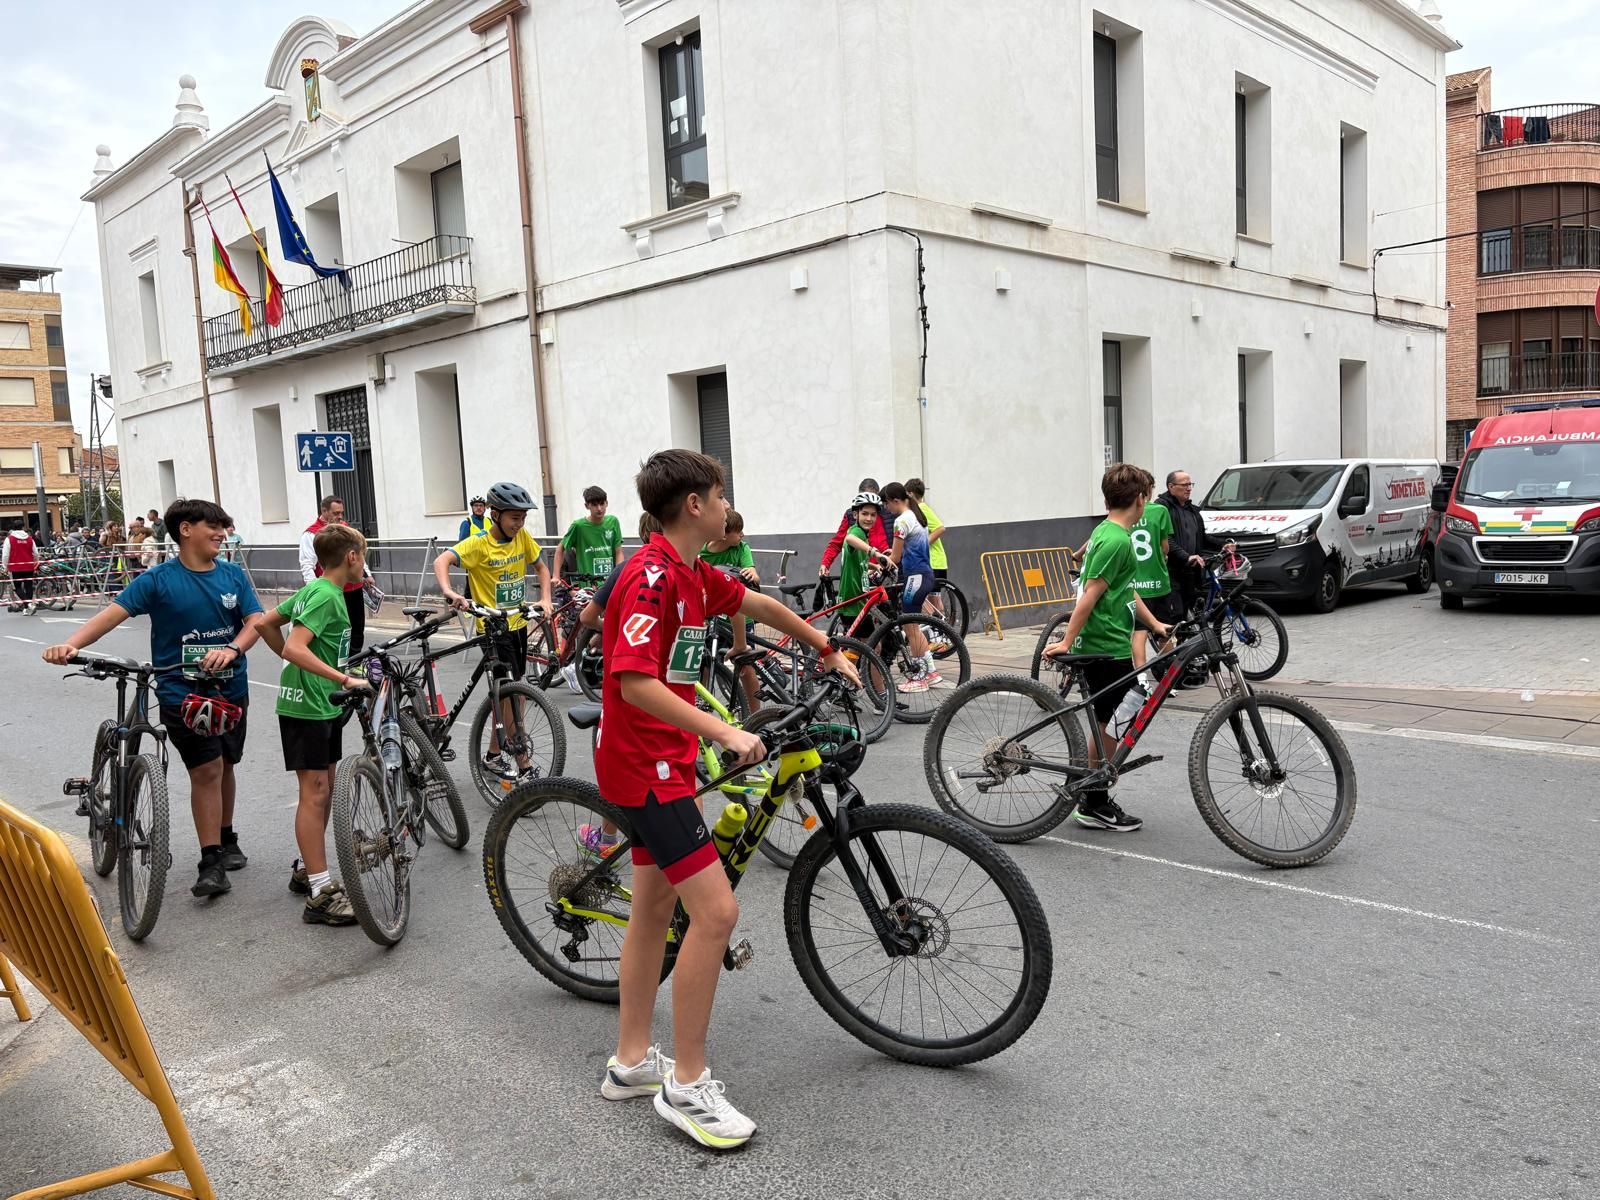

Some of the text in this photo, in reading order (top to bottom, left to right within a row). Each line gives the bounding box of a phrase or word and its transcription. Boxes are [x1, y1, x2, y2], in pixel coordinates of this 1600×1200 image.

[1134, 580, 1154, 589] IMATE
[1500, 574, 1546, 583] 7015 JKP
[502, 586, 523, 602] 186
[683, 629, 702, 640] CAJA
[684, 645, 705, 669] 13
[487, 855, 503, 909] MAXXIS
